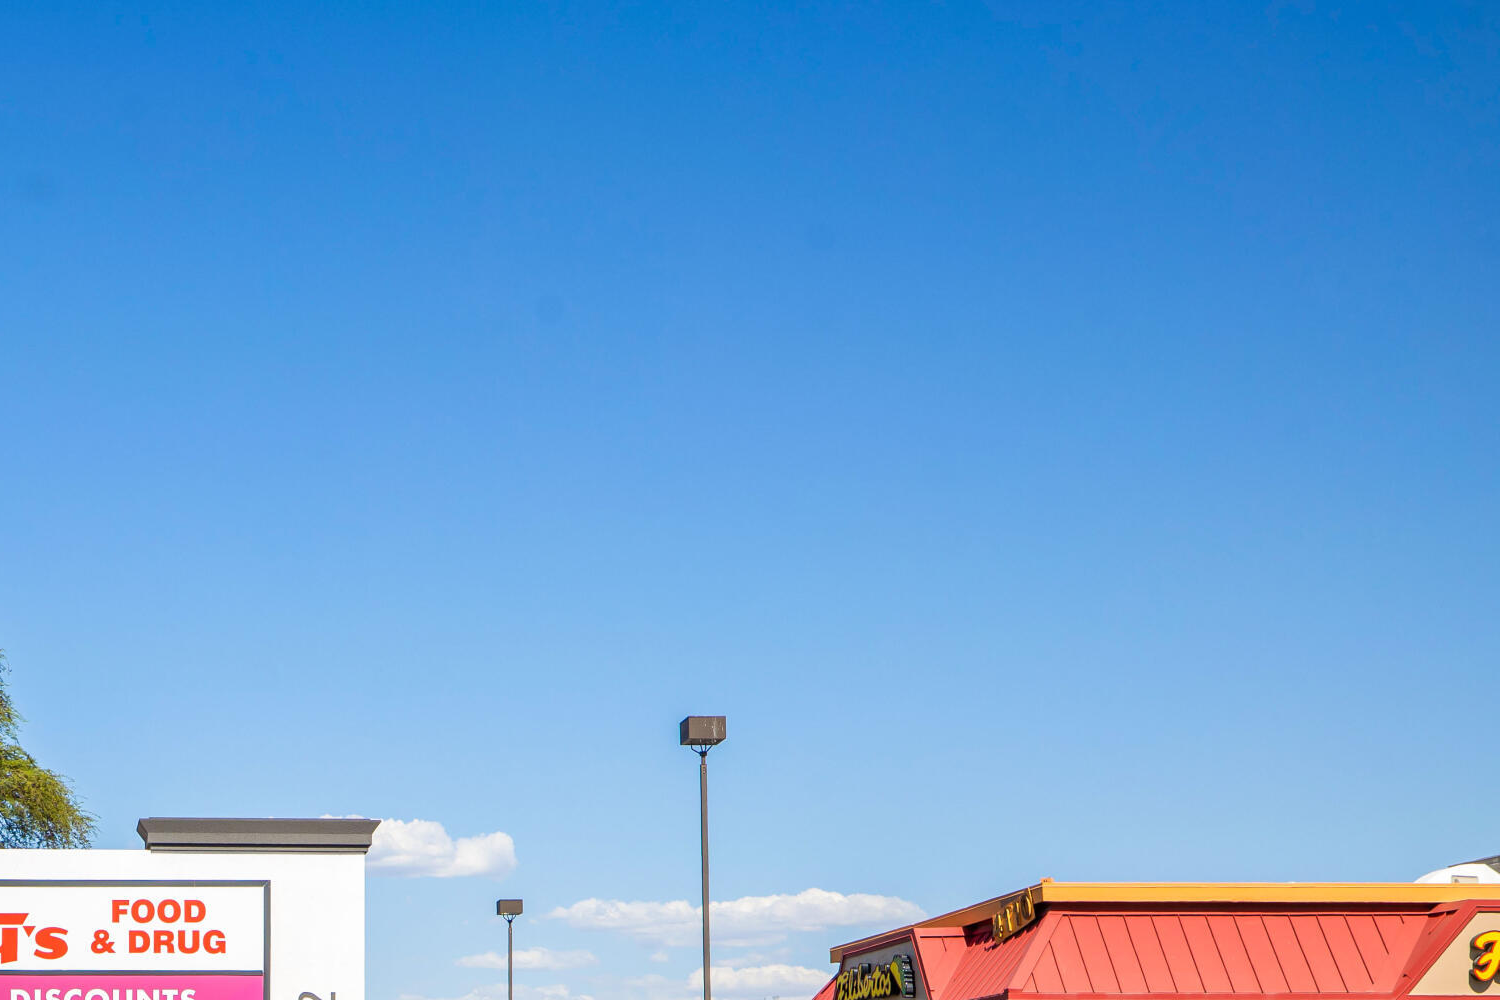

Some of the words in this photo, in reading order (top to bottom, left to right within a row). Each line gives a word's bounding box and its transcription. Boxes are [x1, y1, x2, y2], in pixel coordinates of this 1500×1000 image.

[111, 899, 206, 923] FOOD
[90, 931, 116, 954] &
[128, 930, 227, 955] DRUG
